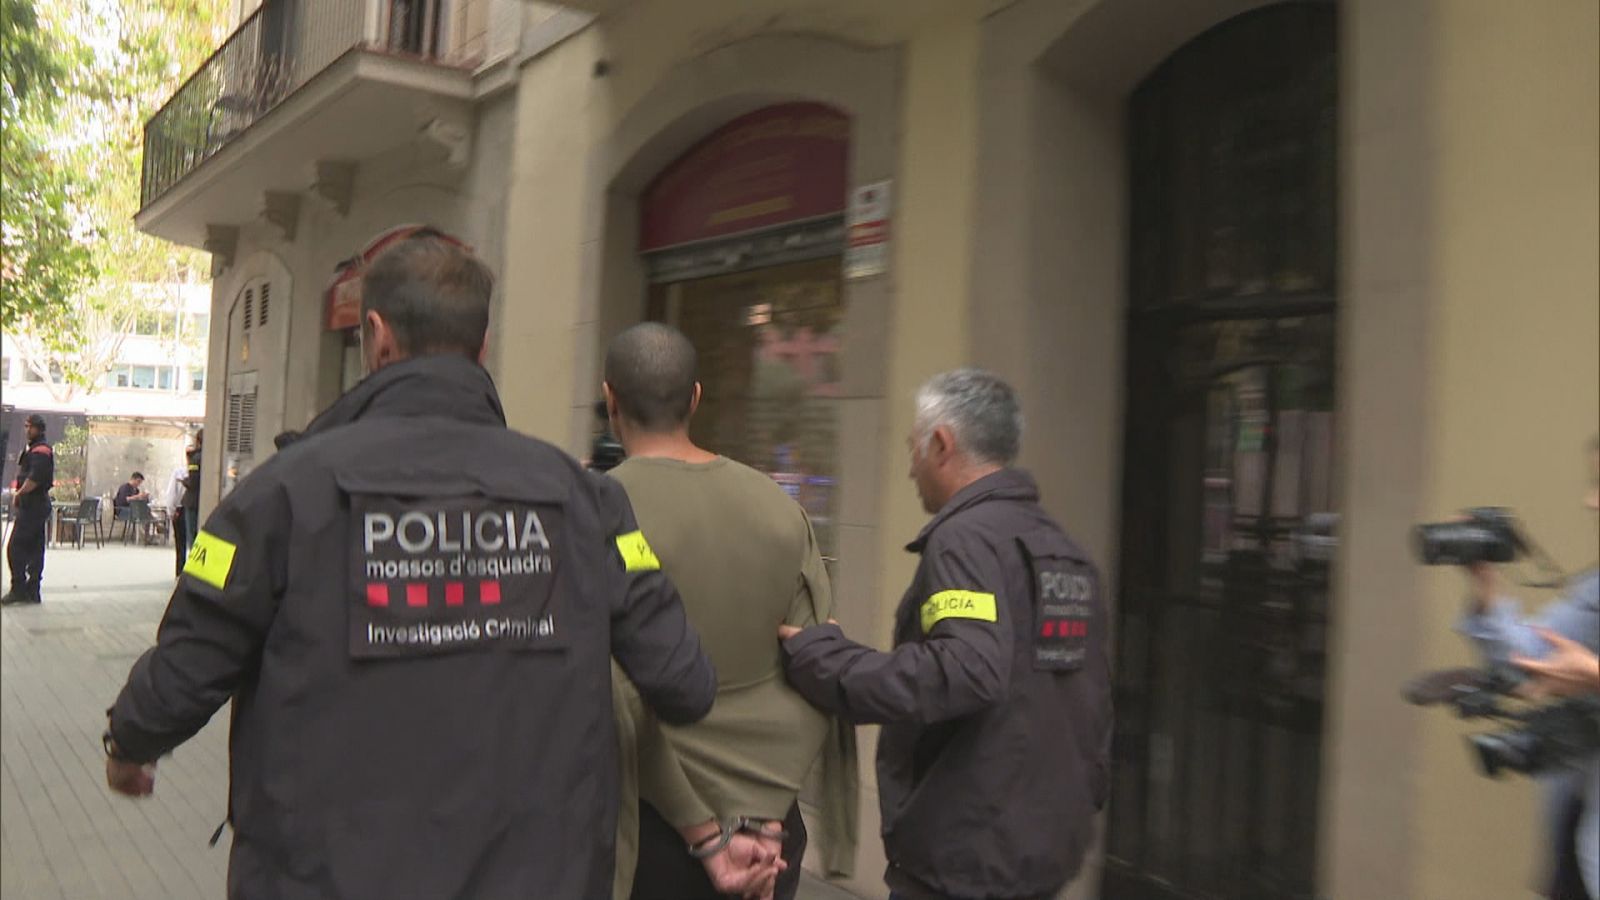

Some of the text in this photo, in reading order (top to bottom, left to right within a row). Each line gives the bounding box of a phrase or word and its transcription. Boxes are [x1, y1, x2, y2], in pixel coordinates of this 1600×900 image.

[364, 510, 551, 554] POLICIA
[366, 552, 552, 579] mossos d'esquadra
[367, 614, 555, 645] Investigació Criminal
